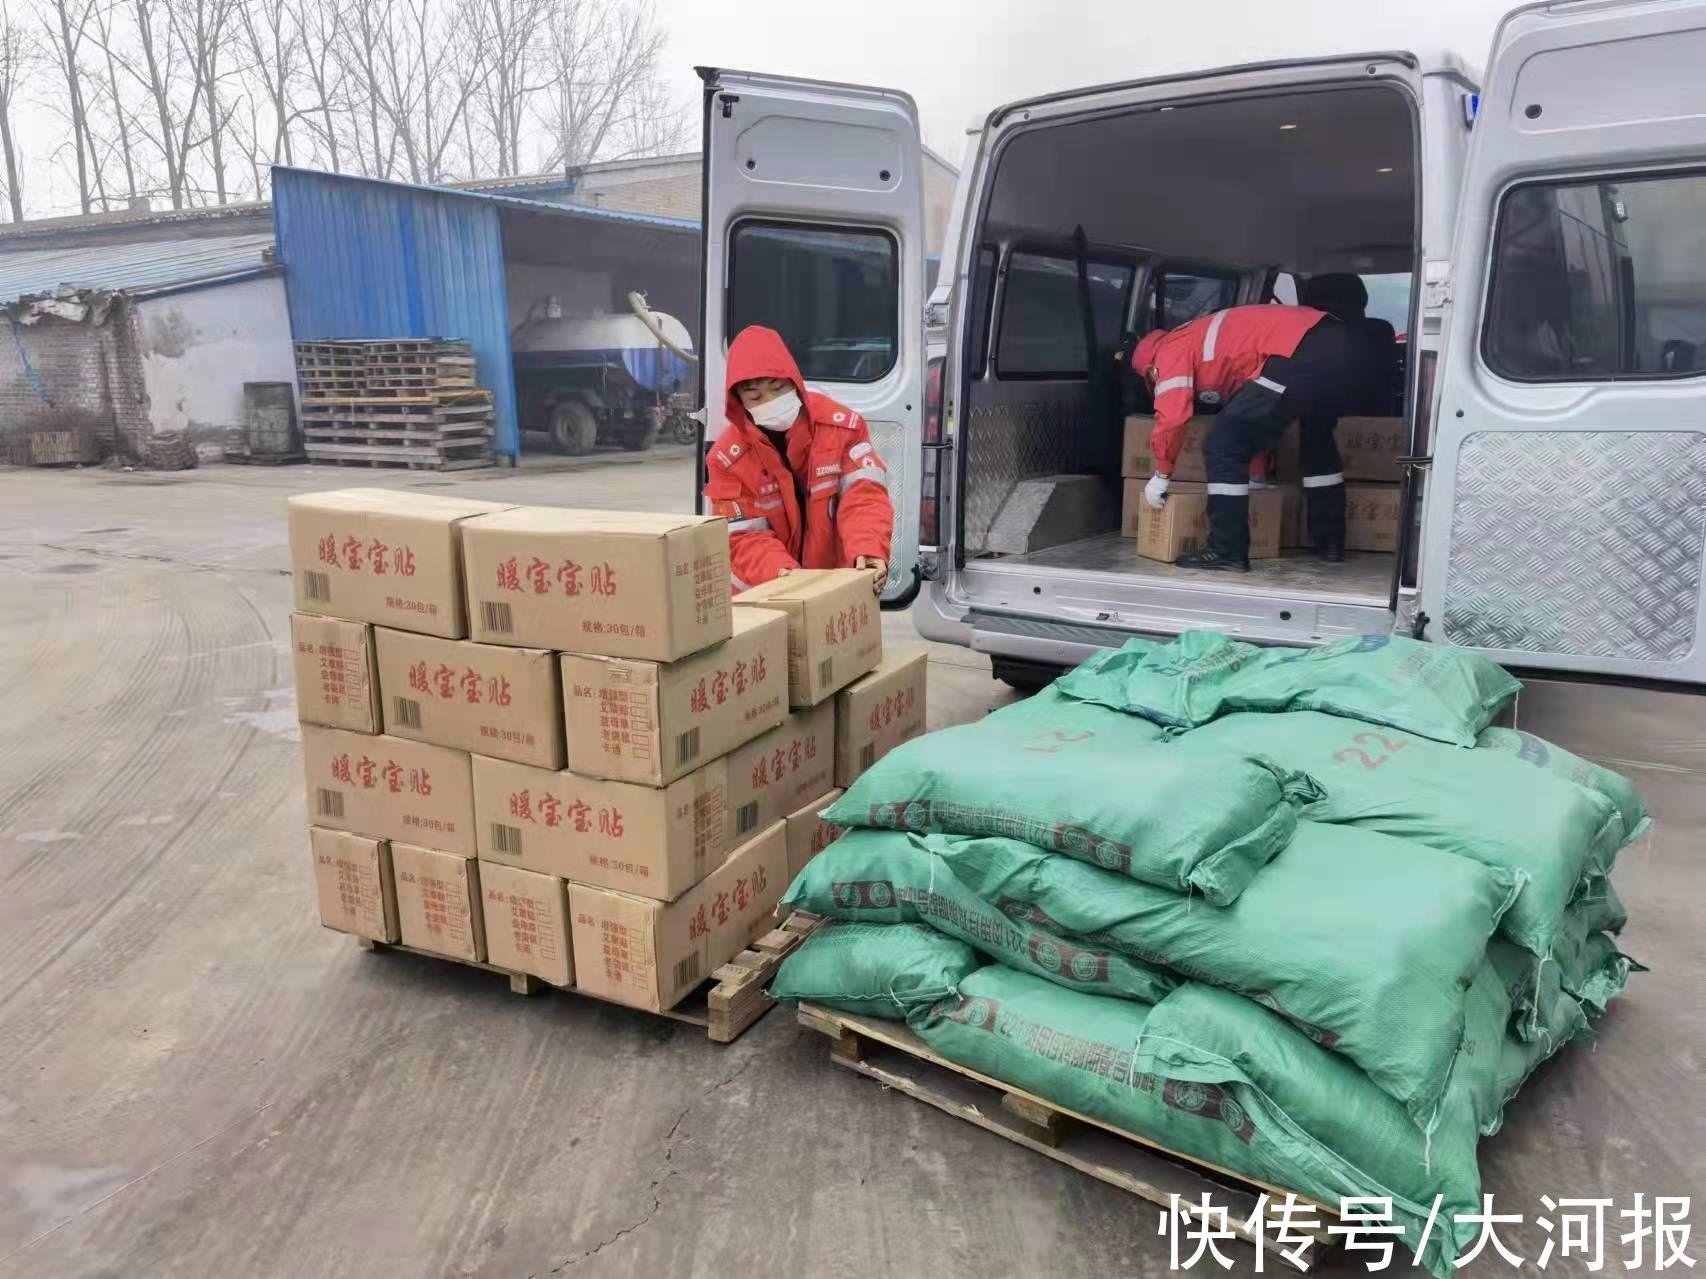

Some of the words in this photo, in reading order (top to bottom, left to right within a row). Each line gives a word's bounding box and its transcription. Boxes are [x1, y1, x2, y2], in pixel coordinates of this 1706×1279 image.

[318, 532, 416, 577] 暖宝宝贴
[496, 556, 617, 598] 暖宝宝贴
[825, 603, 869, 646] 暖宝宝贴
[408, 660, 512, 706] 暖宝宝贴
[690, 654, 767, 714] 暖宝宝贴
[752, 736, 817, 789] 暖宝宝贴
[1332, 730, 1409, 769] 22
[331, 753, 432, 797] 暖宝宝贴
[510, 789, 624, 838] 暖宝宝贴
[688, 864, 767, 937] 暖宝宝贴
